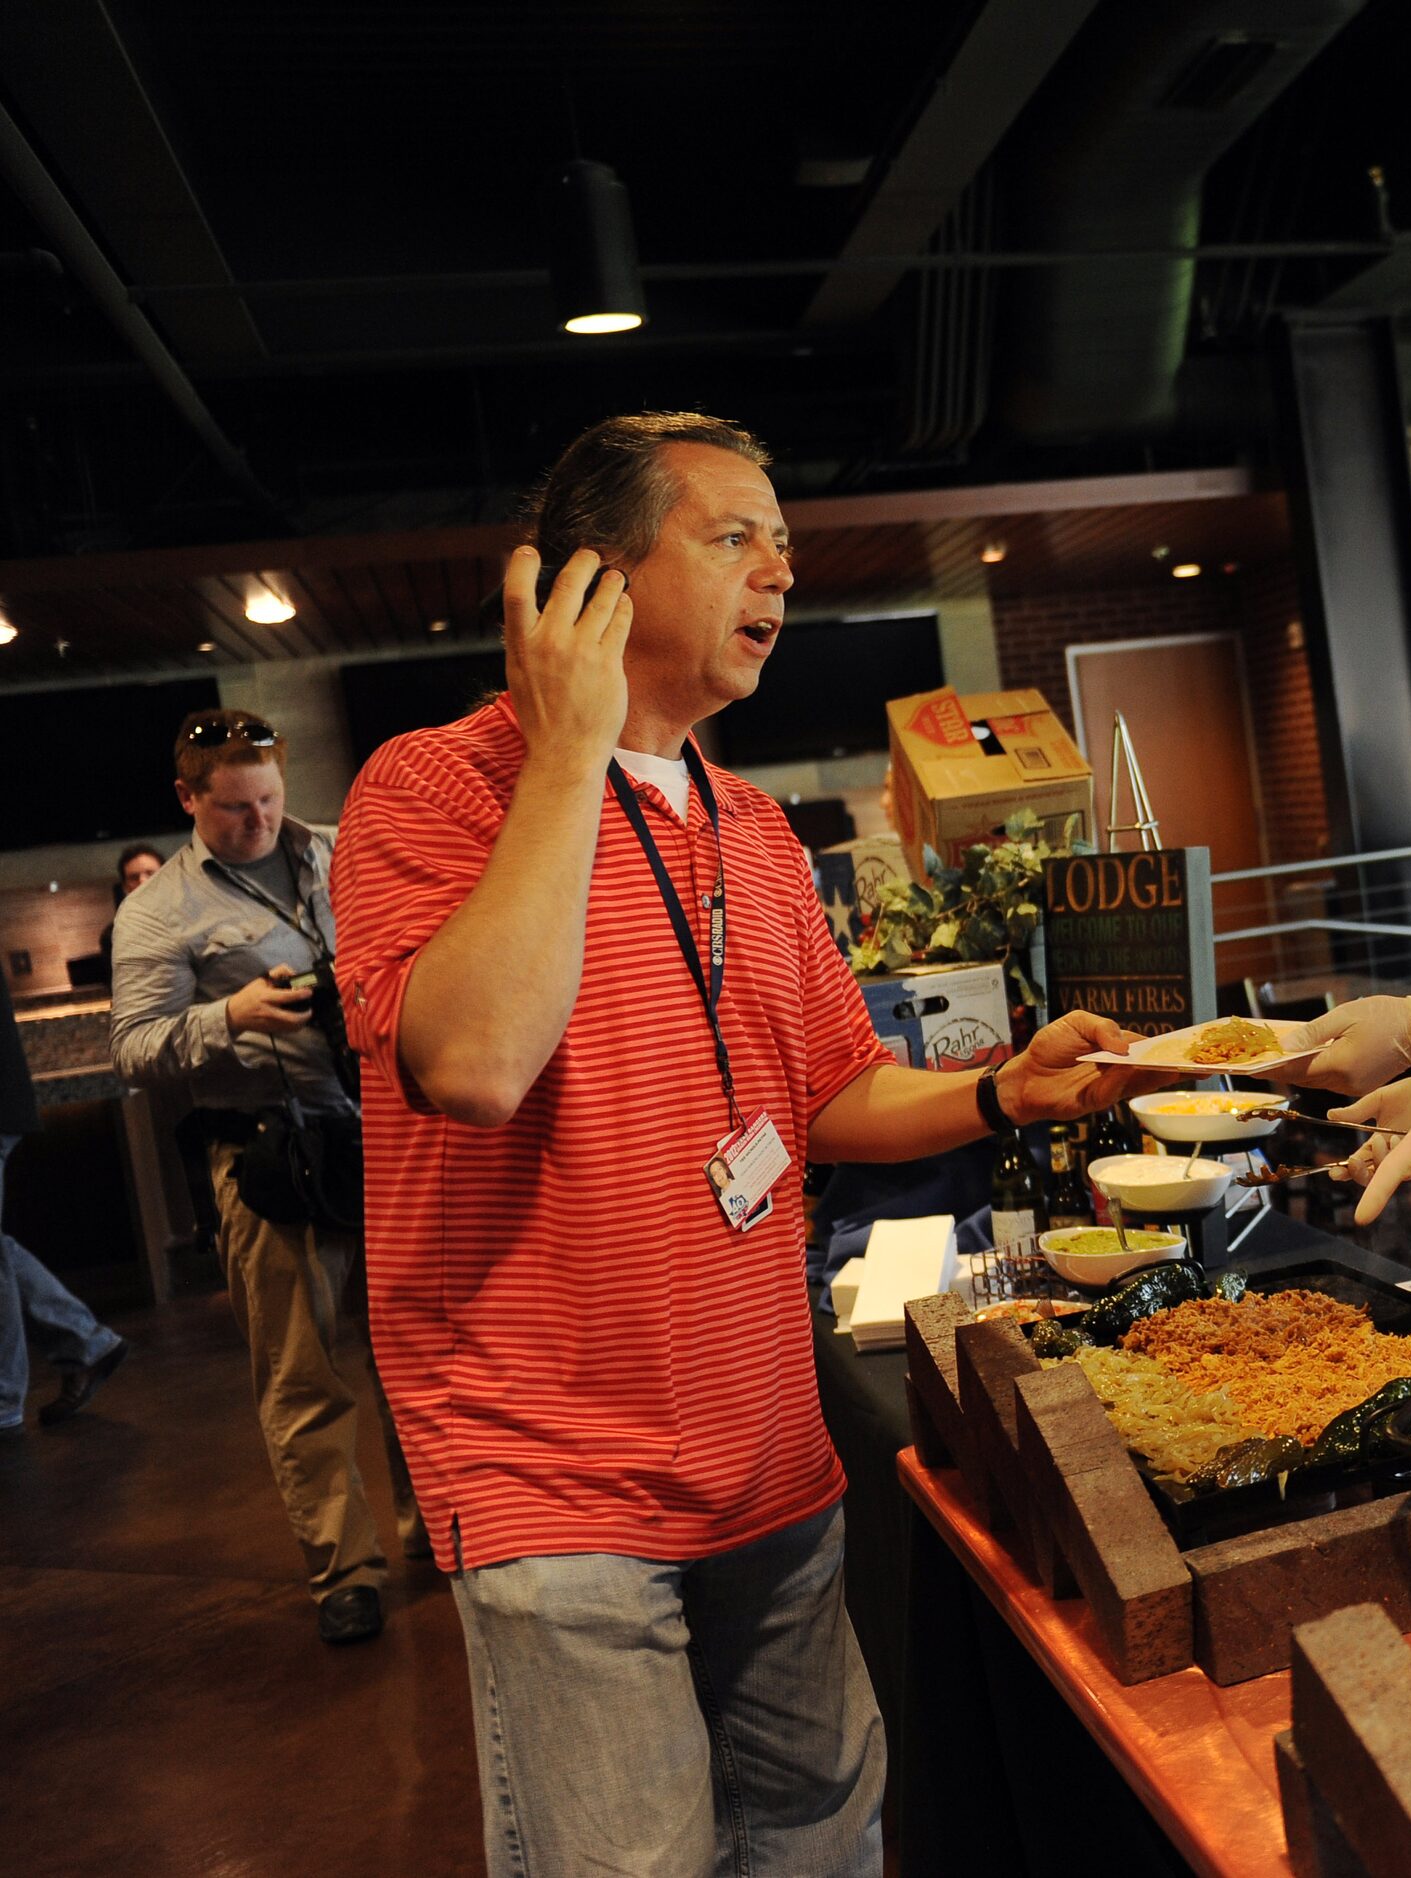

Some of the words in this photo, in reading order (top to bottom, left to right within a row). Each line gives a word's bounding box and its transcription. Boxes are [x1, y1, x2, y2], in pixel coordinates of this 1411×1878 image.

[930, 702, 969, 745] STAR
[1046, 853, 1184, 913] LODGE
[1124, 985, 1186, 1013] FIRES
[933, 1024, 979, 1071] Rahr
